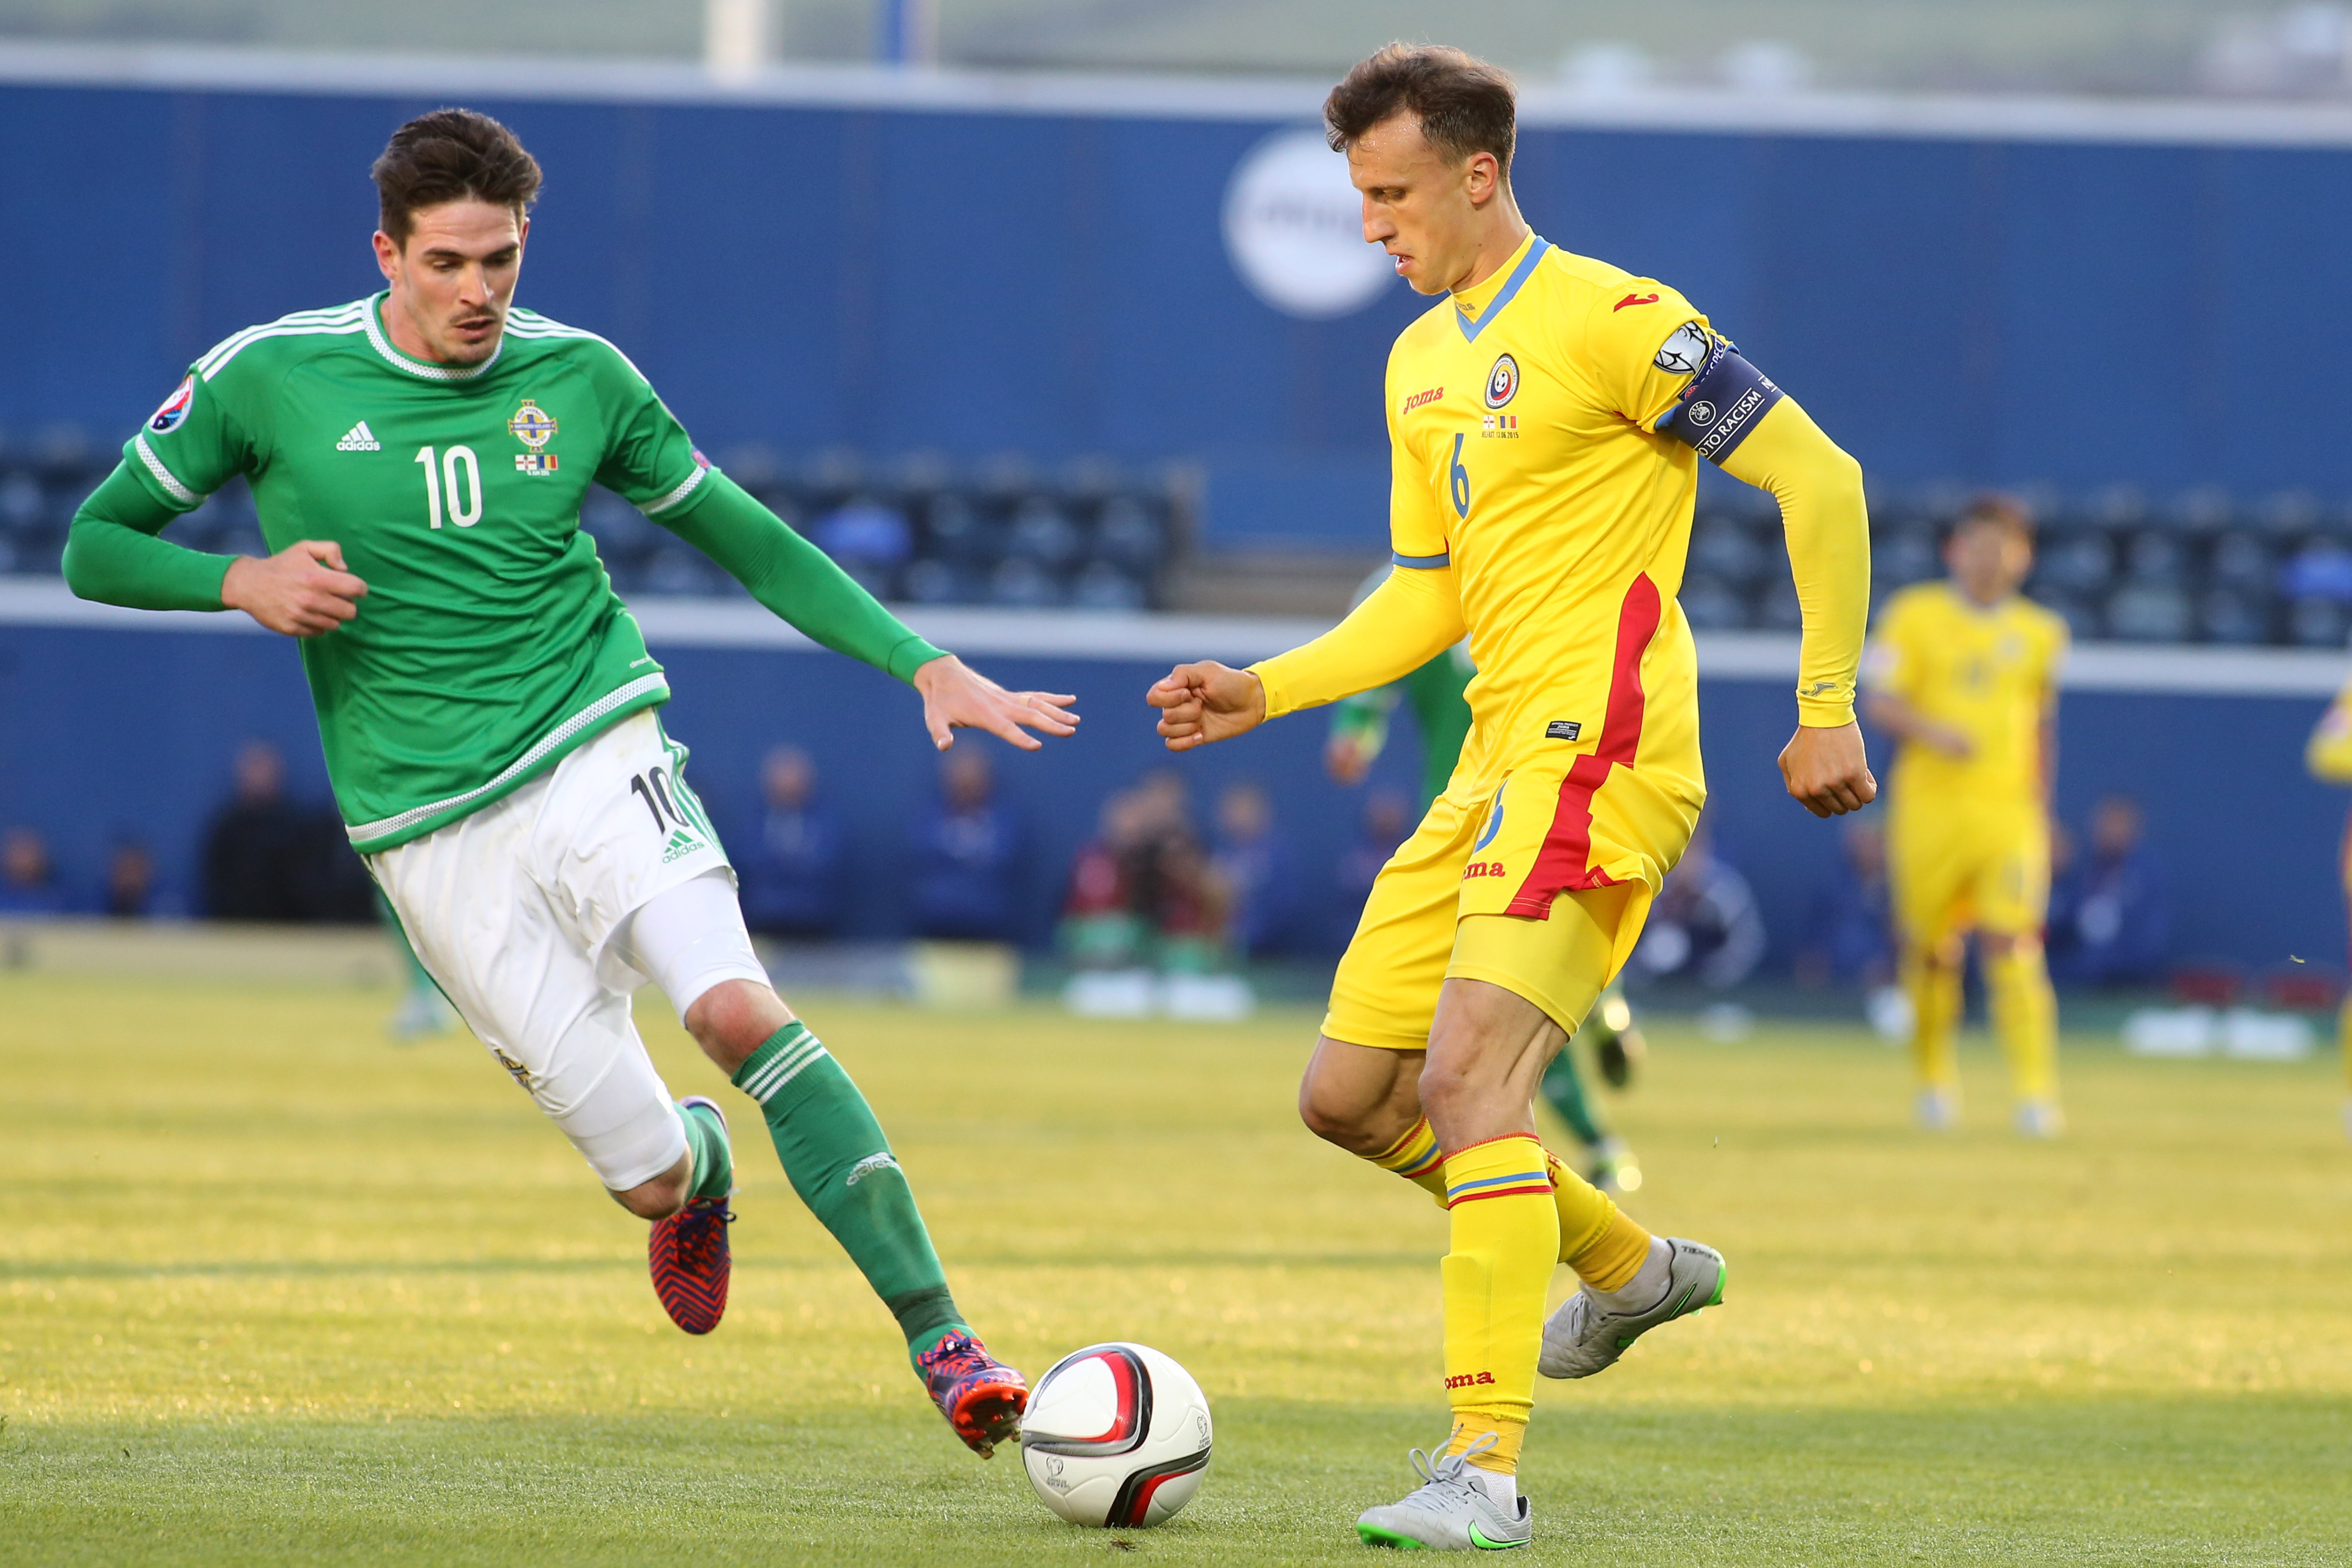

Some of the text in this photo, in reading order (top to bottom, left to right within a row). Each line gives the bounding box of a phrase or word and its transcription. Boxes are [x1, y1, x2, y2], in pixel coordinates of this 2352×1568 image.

[1701, 336, 1724, 383] SPECT
[1690, 403, 1703, 415] UEFA
[1704, 434, 1721, 449] TO
[1718, 391, 1762, 436] RACISM
[336, 440, 381, 451] adidas
[414, 445, 483, 529] 10
[1450, 433, 1470, 519] 6
[631, 766, 690, 836] 10
[662, 842, 705, 864] adidas
[1461, 862, 1506, 882] ma
[1445, 1371, 1496, 1390] oma
